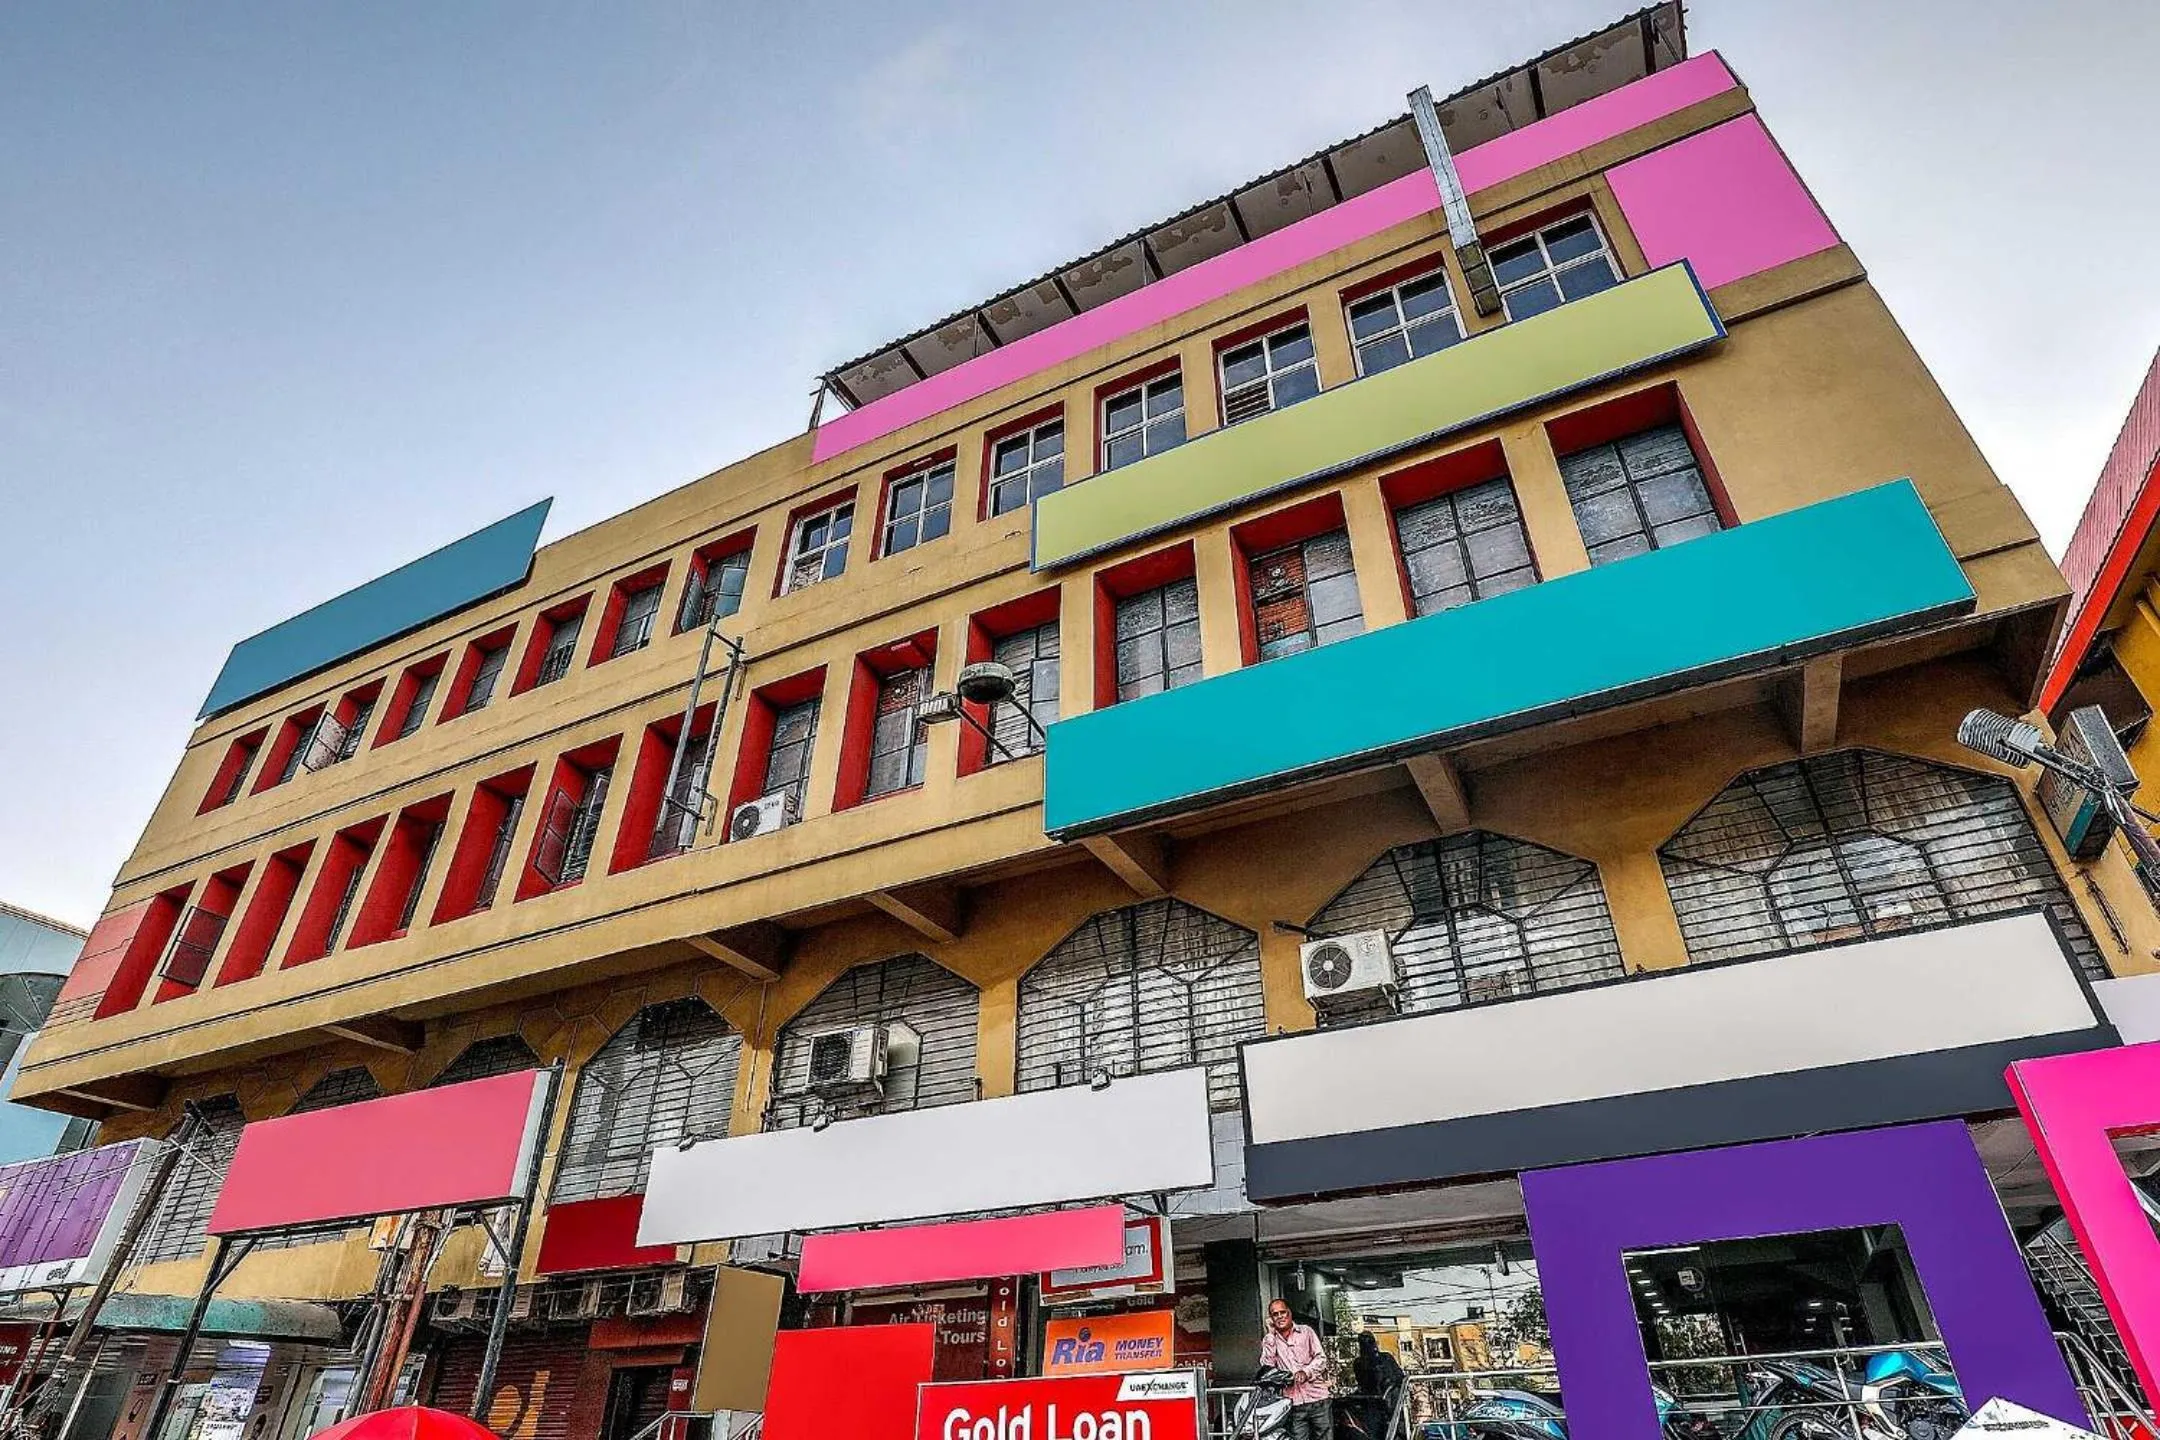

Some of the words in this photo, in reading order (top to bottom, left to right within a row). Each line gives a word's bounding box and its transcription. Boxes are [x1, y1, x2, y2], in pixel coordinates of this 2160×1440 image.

[998, 1276, 1010, 1327] old
[1127, 1295, 1155, 1307] Gold
[889, 1312, 911, 1325] Air
[940, 1330, 986, 1345] Tours
[1051, 1327, 1106, 1366] Ria
[1114, 1337, 1164, 1352] MONEY
[995, 1339, 1008, 1379] Lo
[1114, 1349, 1163, 1361] TRANSFER
[944, 1403, 1032, 1440] Gold
[1047, 1404, 1151, 1440] Loan
